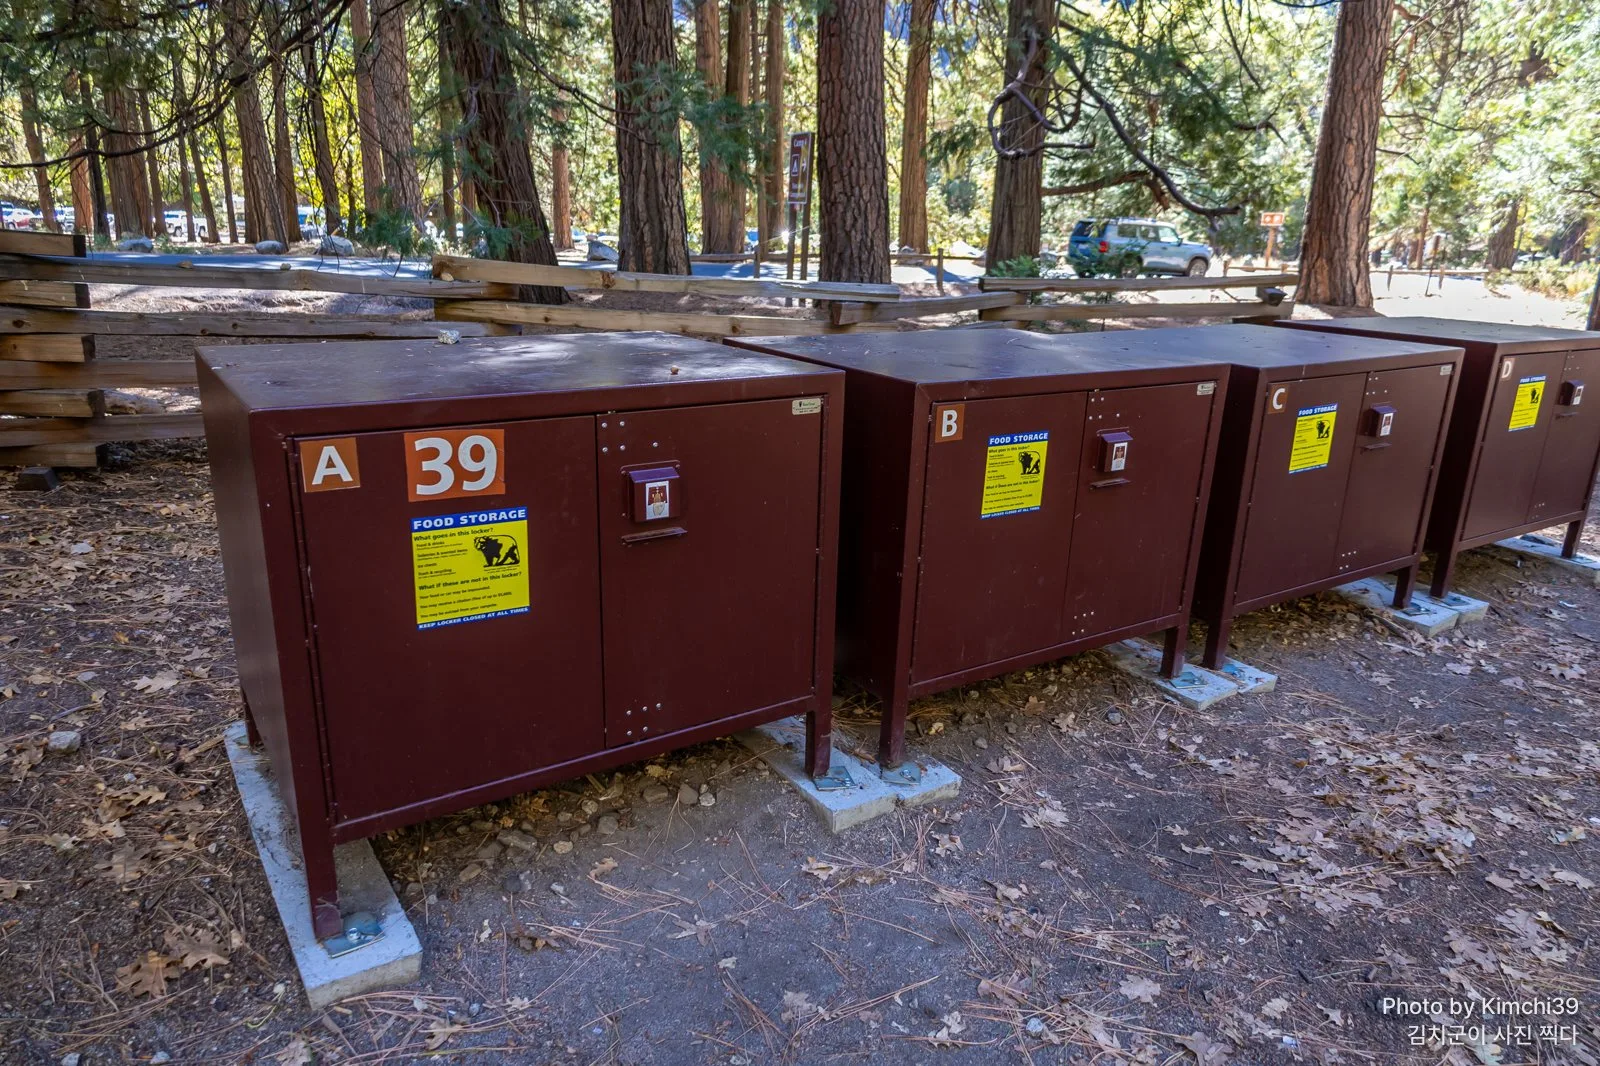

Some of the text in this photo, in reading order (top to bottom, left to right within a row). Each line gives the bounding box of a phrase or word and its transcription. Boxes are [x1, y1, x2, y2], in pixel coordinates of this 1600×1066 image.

[1502, 361, 1512, 378] D
[1272, 388, 1286, 410] C
[942, 410, 957, 437] B
[1014, 433, 1048, 443] STORAGE
[312, 446, 353, 484] A
[414, 435, 498, 495] 39
[414, 510, 526, 529] FOOD STORAGE
